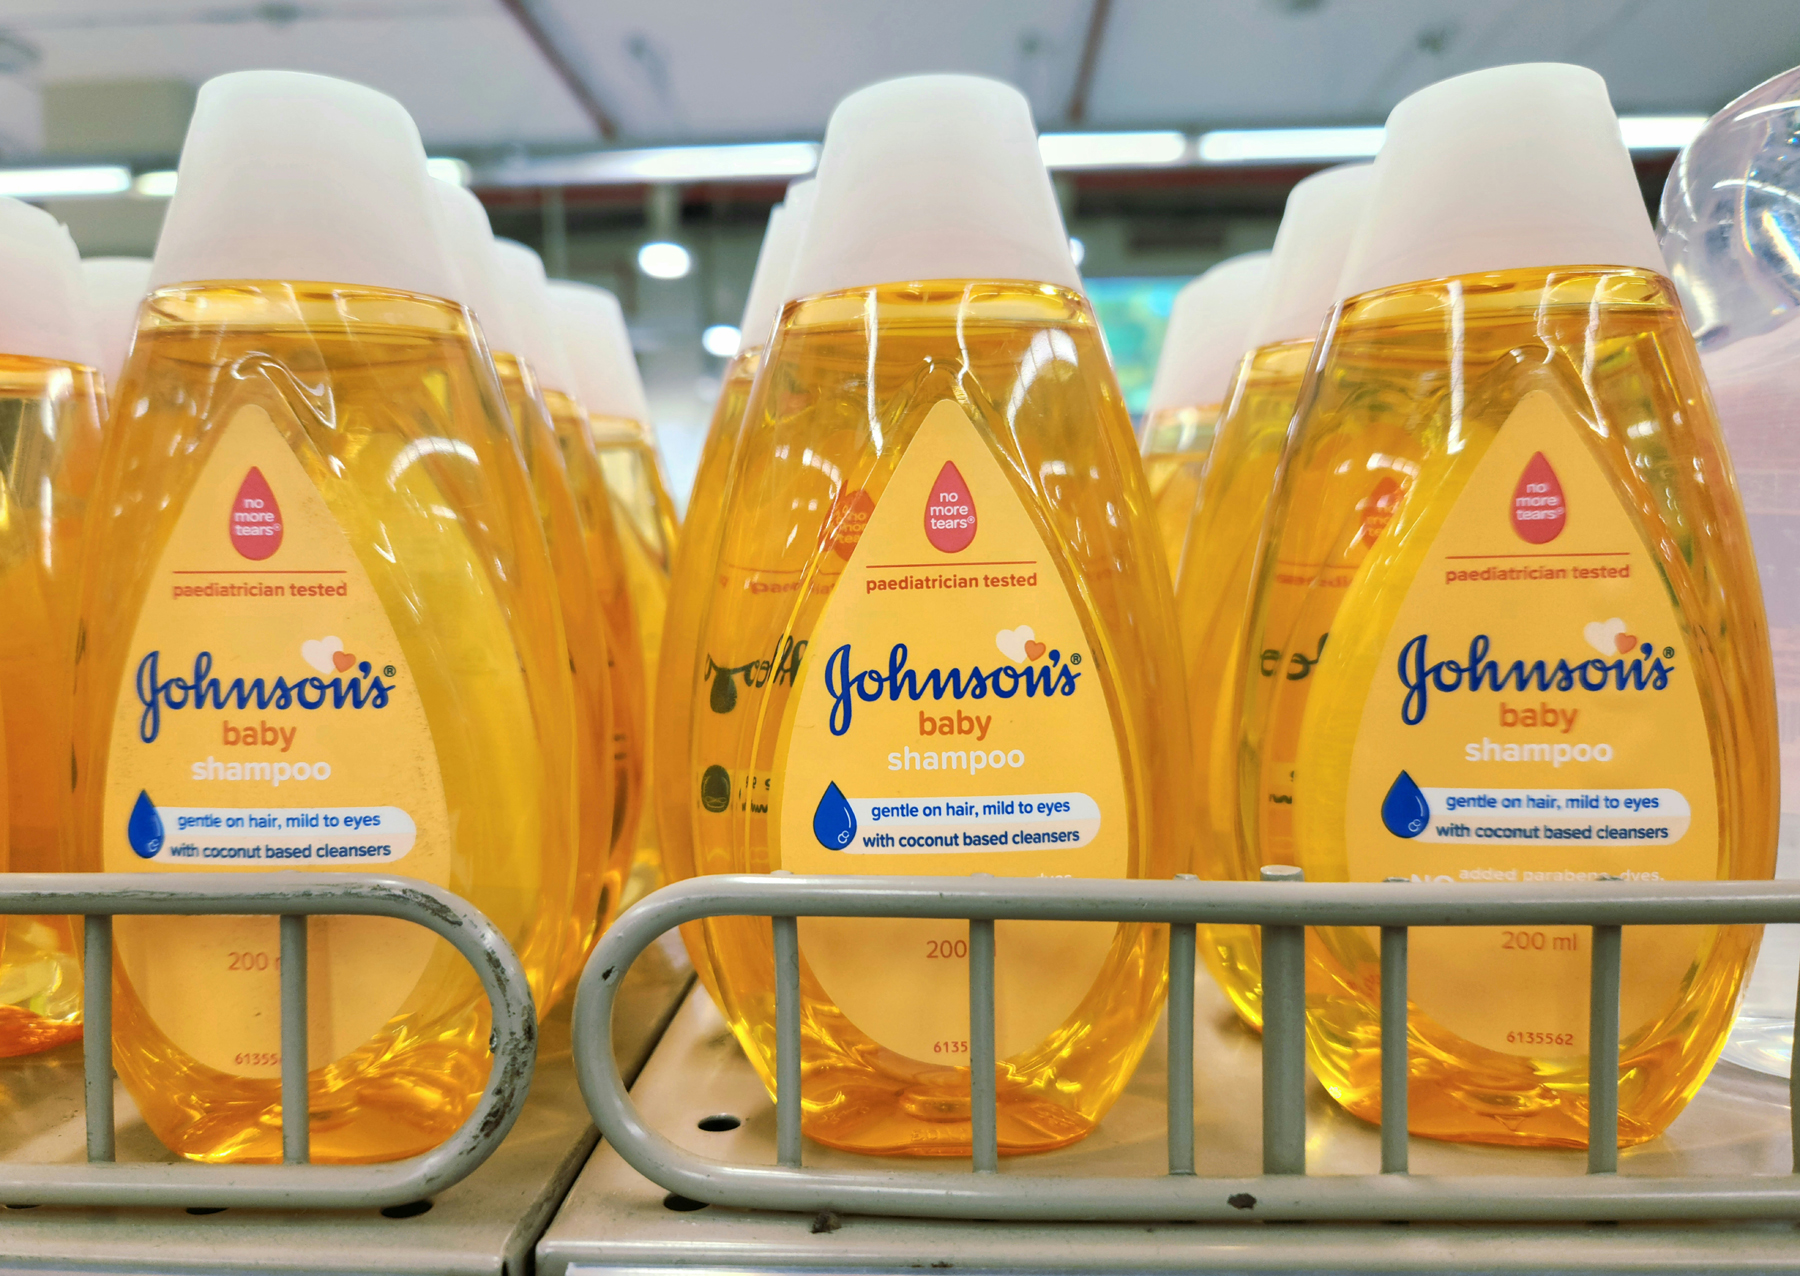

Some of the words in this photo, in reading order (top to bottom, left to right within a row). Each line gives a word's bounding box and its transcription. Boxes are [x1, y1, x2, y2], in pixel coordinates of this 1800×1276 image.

[1526, 482, 1548, 493] no
[244, 498, 264, 509] no
[940, 492, 958, 503] no
[1516, 496, 1557, 507] more
[235, 511, 275, 522] more
[930, 505, 968, 516] more
[1445, 566, 1567, 584] paediatrician
[1572, 564, 1630, 579] tested
[173, 582, 285, 600] paediatrician
[289, 582, 347, 598] tested
[866, 575, 978, 594] paediatrician
[983, 573, 1037, 589] tested
[919, 710, 992, 741] baby
[1499, 702, 1579, 733] baby
[223, 720, 296, 752] baby
[887, 746, 1025, 775] shampoo
[1465, 737, 1613, 768] shampoo
[191, 756, 332, 787] shampoo
[871, 802, 918, 820] gentle
[923, 804, 942, 816] on
[946, 801, 979, 818] hair,
[982, 800, 1014, 815] mild
[1018, 801, 1033, 814] to
[1037, 800, 1070, 816] eyes
[1446, 795, 1497, 810] gentle
[1501, 797, 1522, 808] on
[1526, 795, 1561, 810] hair,
[1565, 795, 1599, 809] mild
[1604, 796, 1618, 809] to
[1622, 797, 1659, 811] eyes
[178, 814, 222, 830] gentle
[226, 816, 245, 827] on
[248, 814, 282, 830] hair,
[286, 814, 320, 828] mild
[323, 814, 339, 828] to
[343, 816, 381, 830] eyes
[863, 832, 894, 848] with
[899, 832, 959, 848] coconut
[962, 831, 1008, 847] based
[1011, 829, 1080, 845] cleansers
[1436, 824, 1470, 838] with
[1475, 825, 1540, 839] coconut
[1544, 825, 1592, 839] based
[1596, 825, 1669, 839] cleansers
[170, 844, 199, 857] with
[202, 846, 262, 859] coconut
[266, 845, 311, 858] based
[316, 843, 391, 857] cleansers
[926, 939, 968, 958] 200
[1502, 931, 1546, 950] 200
[1553, 933, 1577, 951] ml
[228, 951, 268, 971] 200
[933, 1041, 968, 1053] 6135
[1506, 1031, 1574, 1046] 6135562
[235, 1052, 281, 1066] 61355
